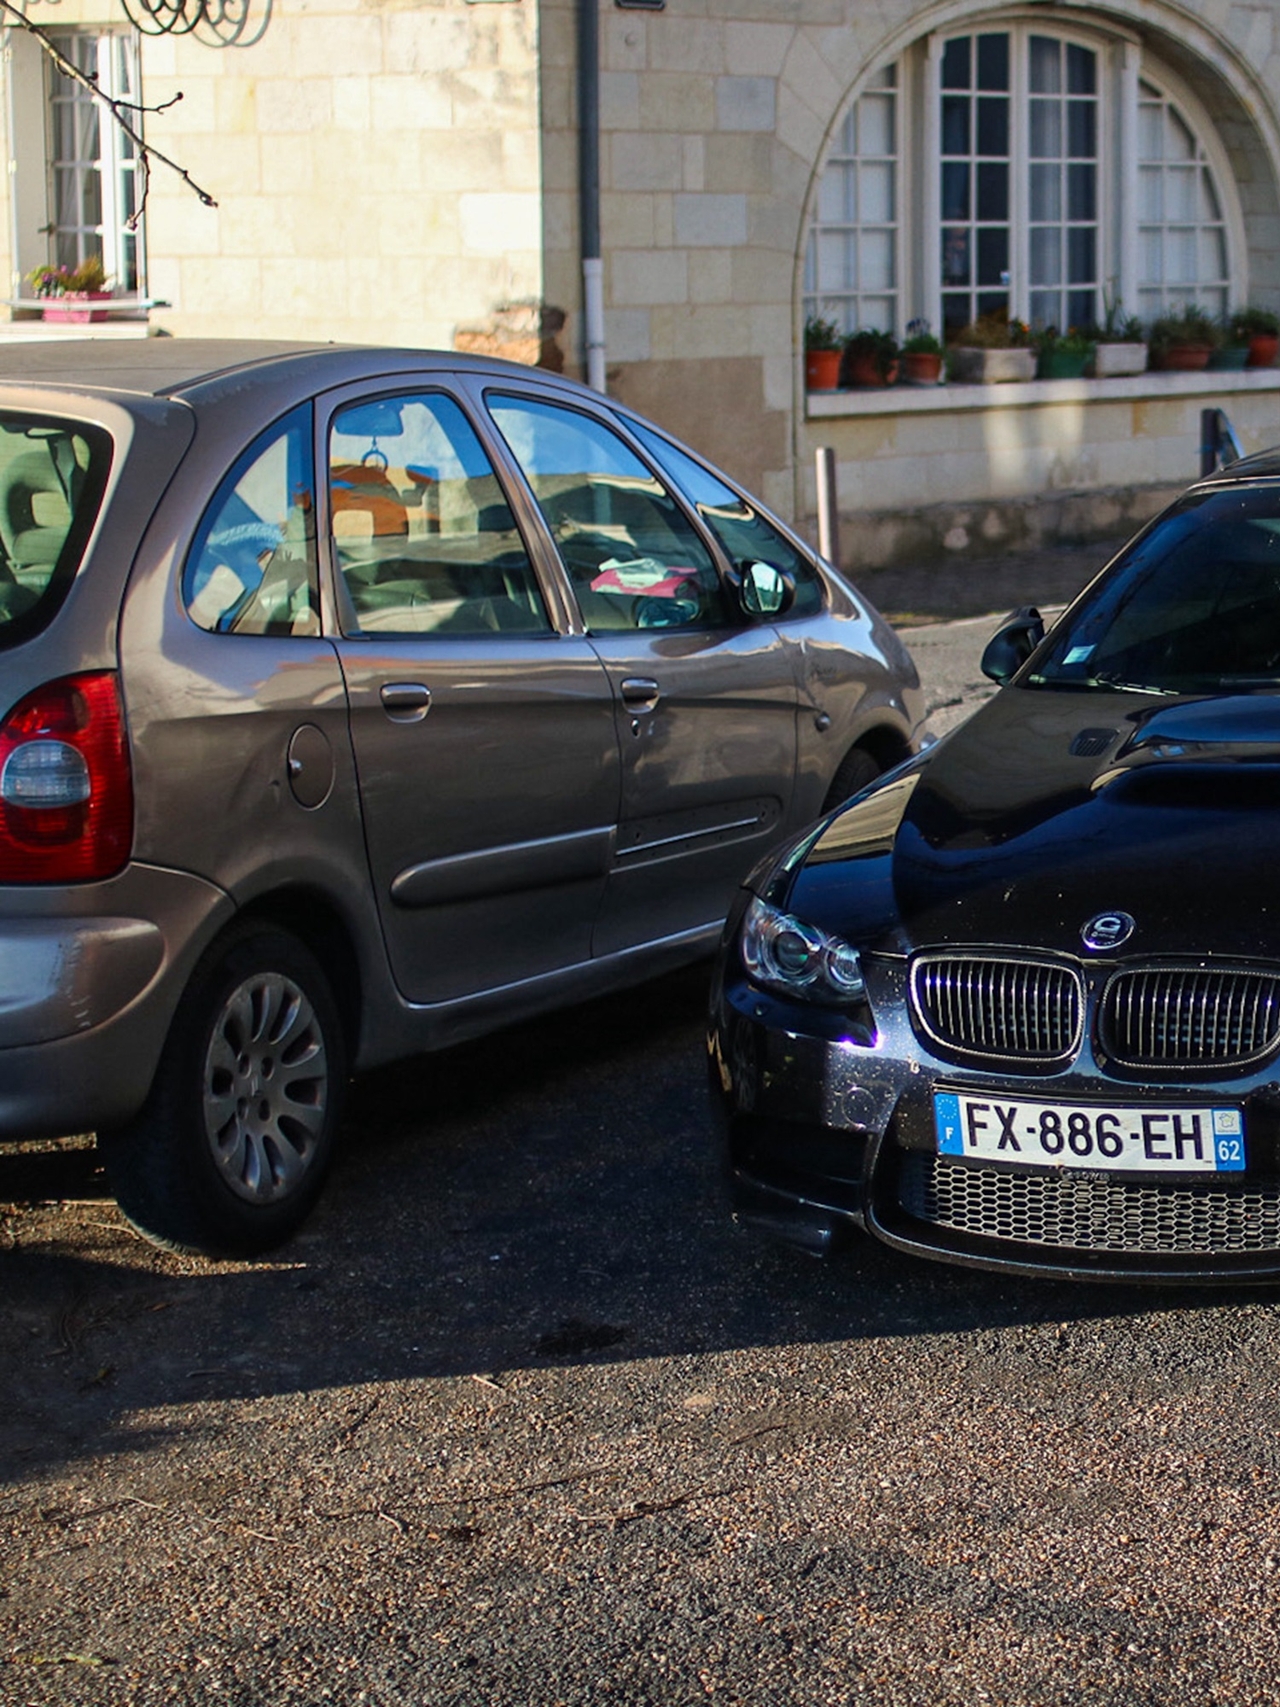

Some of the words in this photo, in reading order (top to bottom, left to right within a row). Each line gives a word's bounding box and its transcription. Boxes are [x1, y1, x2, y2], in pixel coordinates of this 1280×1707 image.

[945, 1127, 954, 1140] F
[966, 1102, 1204, 1160] FX-886-EH
[1219, 1140, 1241, 1161] 62
